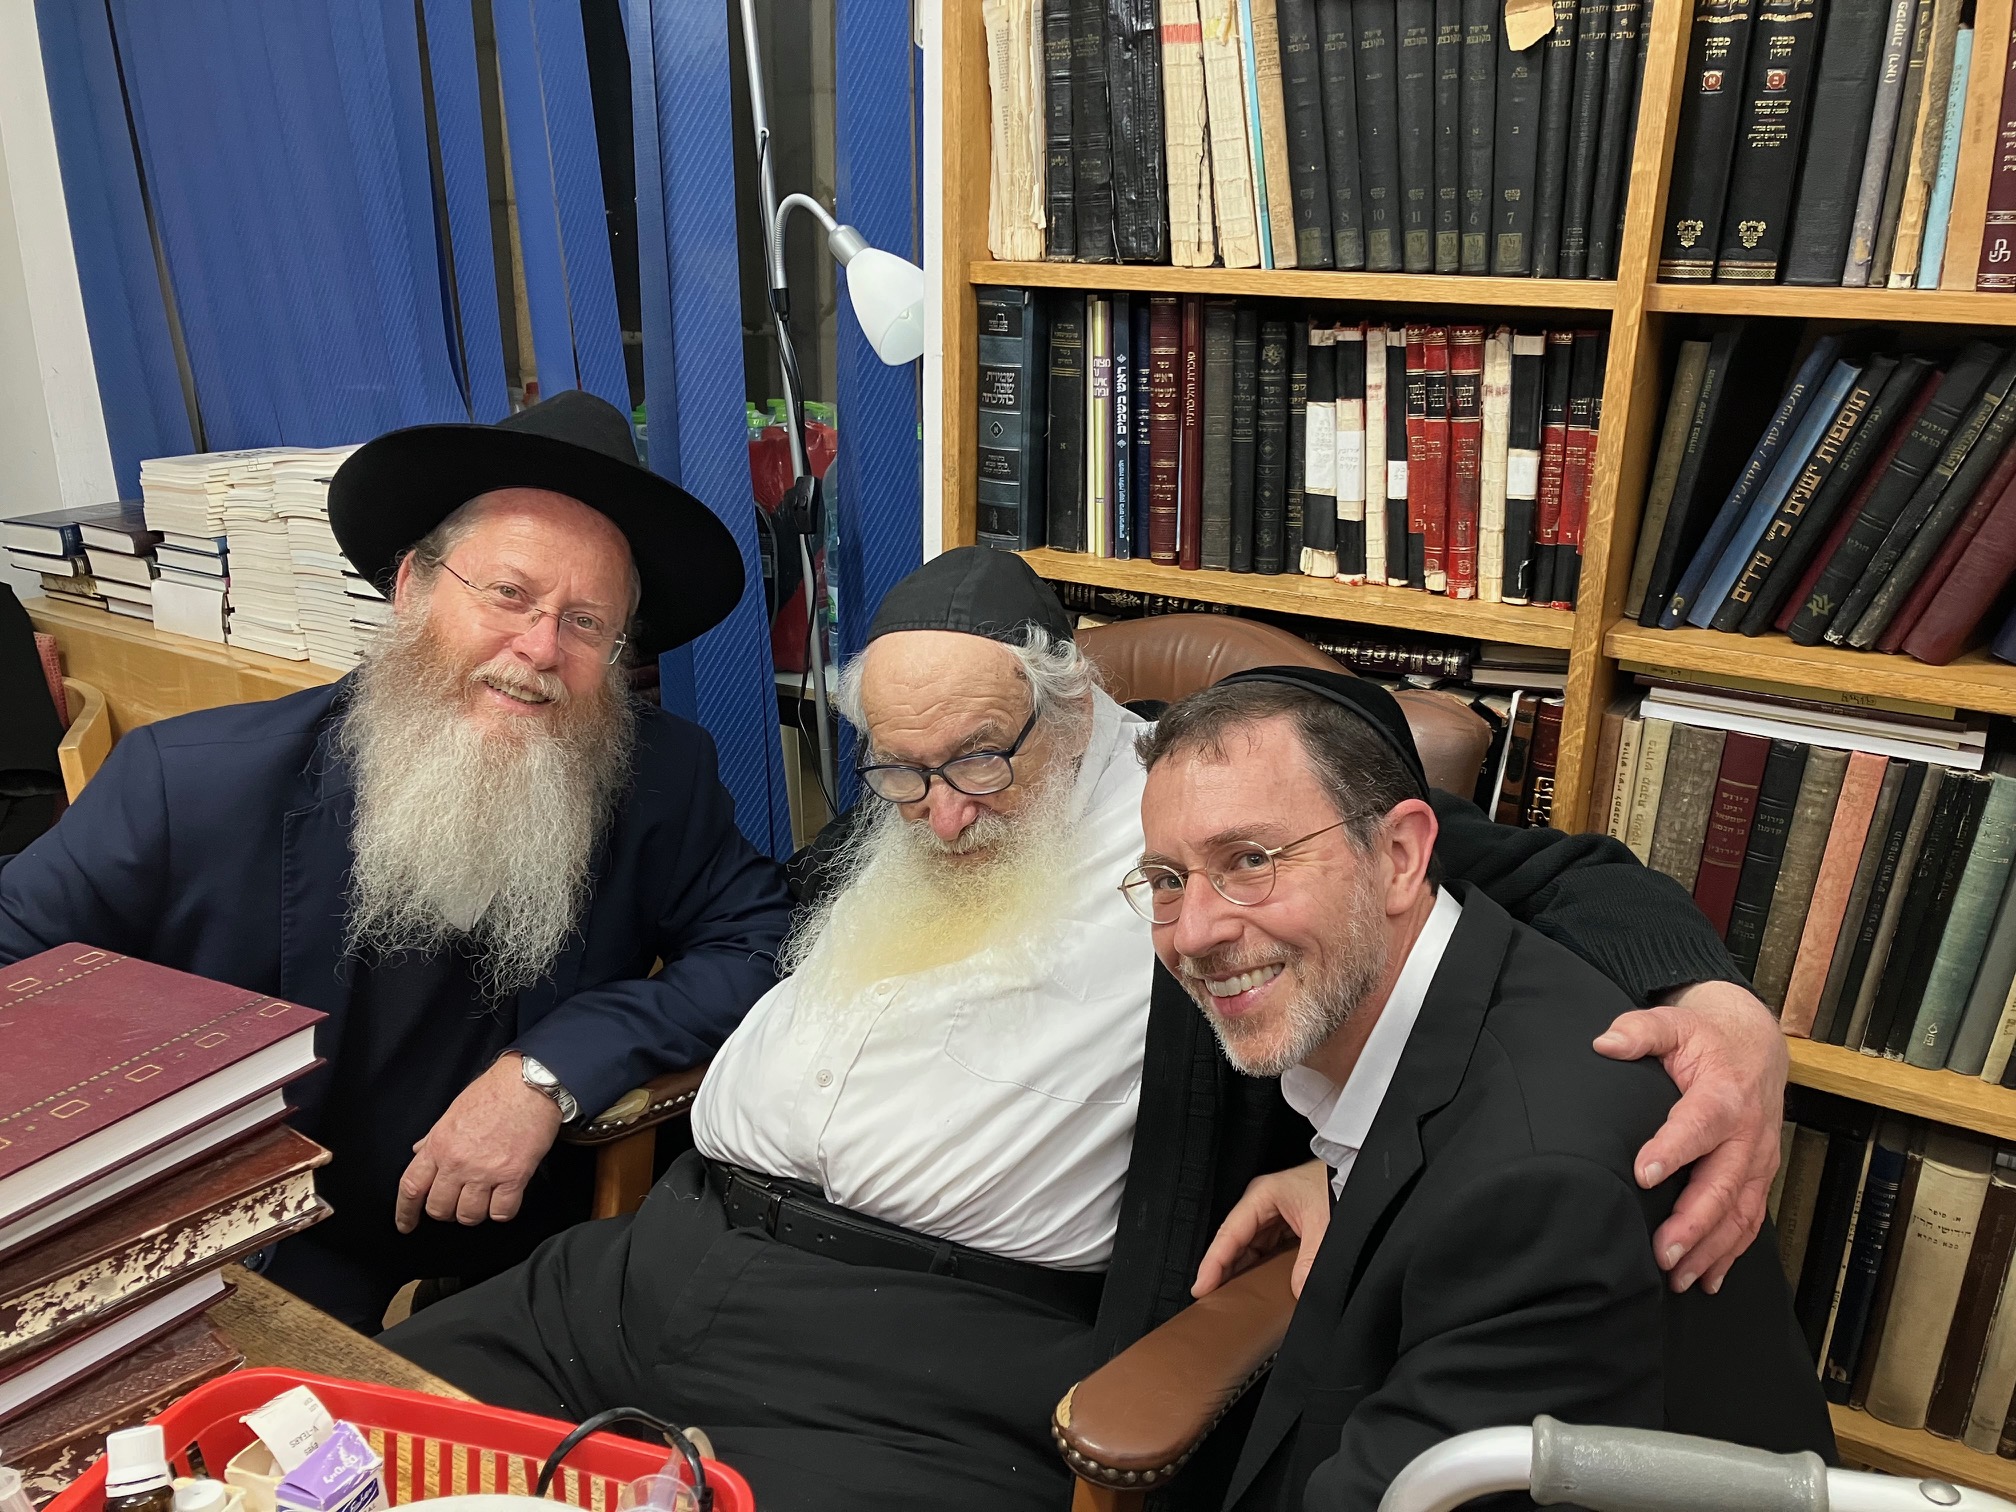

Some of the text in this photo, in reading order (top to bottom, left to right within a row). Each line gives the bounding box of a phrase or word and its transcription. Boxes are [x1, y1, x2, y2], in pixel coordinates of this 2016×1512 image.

[1437, 34, 1461, 45] מקובצת
[1466, 34, 1491, 45] מקובצת
[1705, 37, 1731, 47] מסכת
[1769, 36, 1796, 45] מסכת
[1706, 47, 1728, 61] חולין
[1769, 46, 1792, 60] חולין
[1305, 209, 1312, 221] 9
[1342, 212, 1350, 222] 8
[1373, 208, 1385, 221] 10
[1412, 211, 1420, 223] 11
[1444, 211, 1452, 223] 5
[1470, 211, 1478, 225] 6
[1507, 211, 1514, 225] 7
[986, 371, 1015, 383] שמירת
[1153, 373, 1174, 383] ראש
[993, 382, 1015, 394] שבת
[982, 392, 1015, 406] כהלכתה
[1116, 366, 1127, 435] ראש בשמים
[1816, 386, 1870, 464] תוספות
[1919, 418, 1950, 436] חידושי
[1840, 406, 1882, 471] עבודת הלוים
[1732, 460, 1761, 505] קידושין
[1782, 462, 1822, 516] ישנים
[1847, 538, 1870, 552] חולין
[1731, 550, 1772, 603] נדרים
[1619, 741, 1630, 767] פירוש
[1642, 738, 1657, 771] פירוש
[1615, 771, 1625, 791] רש״י
[1636, 776, 1652, 808] מסכת
[1721, 791, 1750, 804] פירוש
[1610, 795, 1623, 824] למסכת
[1723, 803, 1743, 813] רבינו
[1715, 812, 1747, 823] ישמעאל
[1760, 813, 1785, 824] פירוש
[1757, 824, 1783, 835] קדמון
[1885, 829, 1904, 861] תוספות
[1938, 1225, 1971, 1238] חידושי
[1917, 1232, 1959, 1250] בבא בתרא
[289, 1425, 320, 1449] V-TEARS
